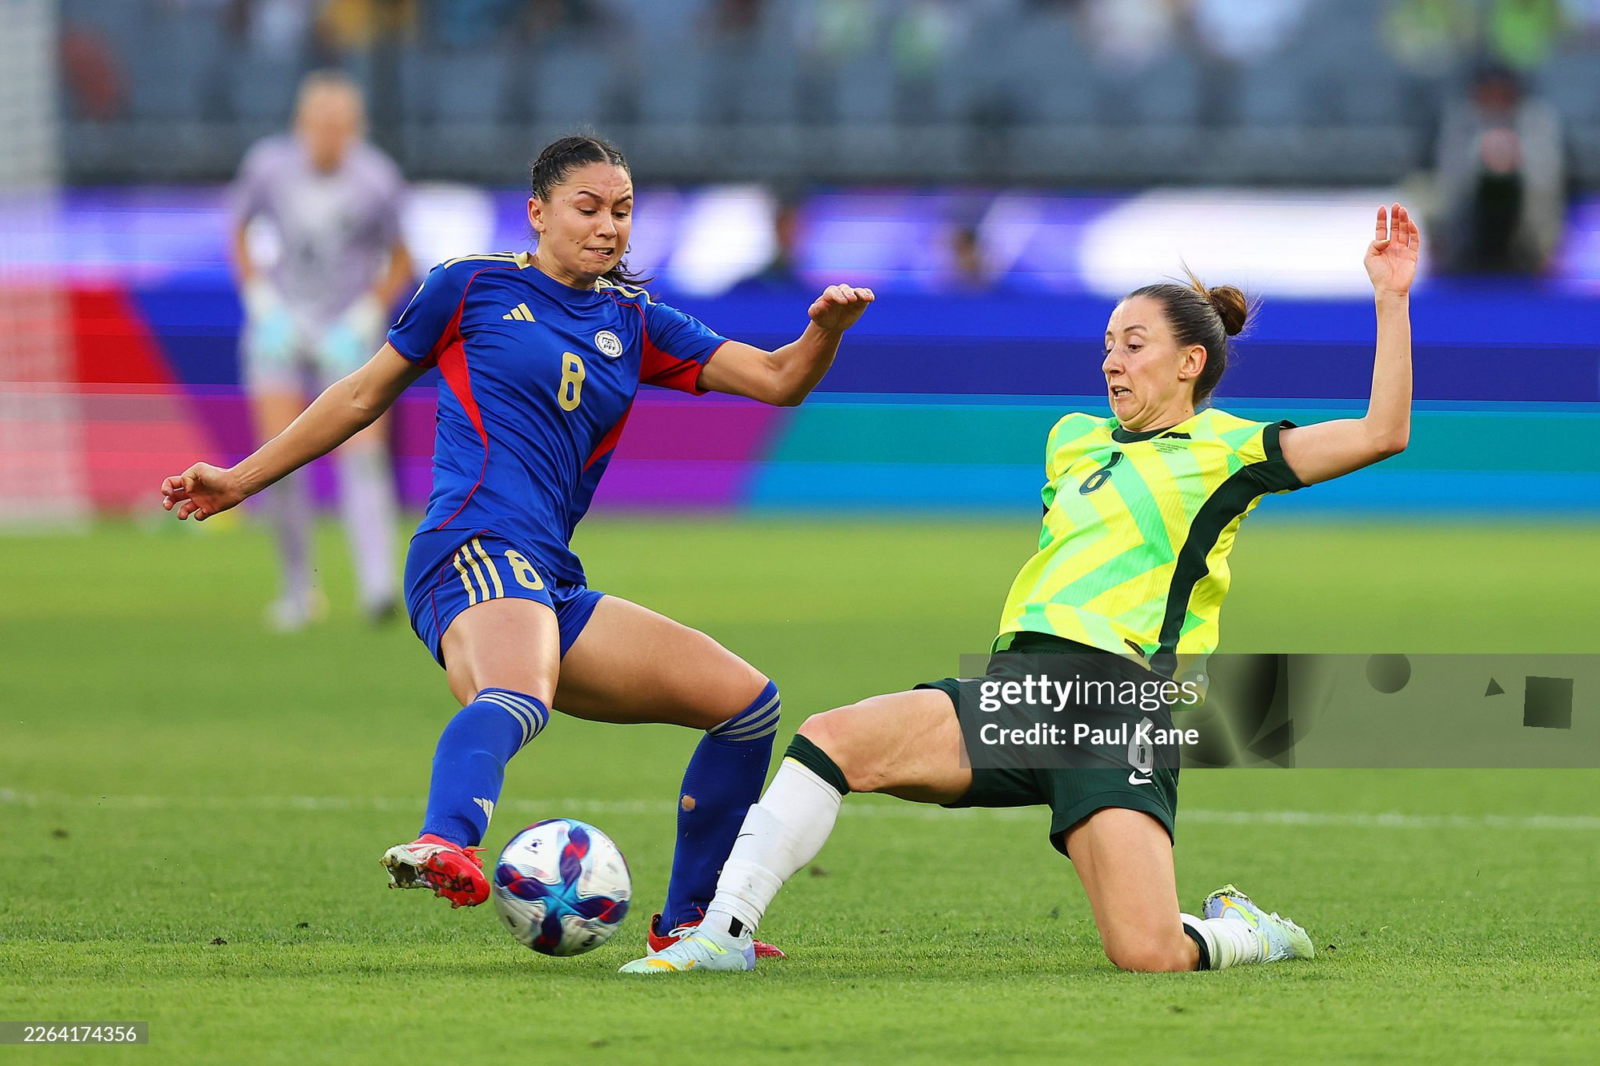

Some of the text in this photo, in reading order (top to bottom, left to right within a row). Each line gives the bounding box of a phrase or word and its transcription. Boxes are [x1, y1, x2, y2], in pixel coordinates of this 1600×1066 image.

[557, 351, 586, 412] 8
[1079, 451, 1124, 496] 6
[504, 549, 545, 591] 8
